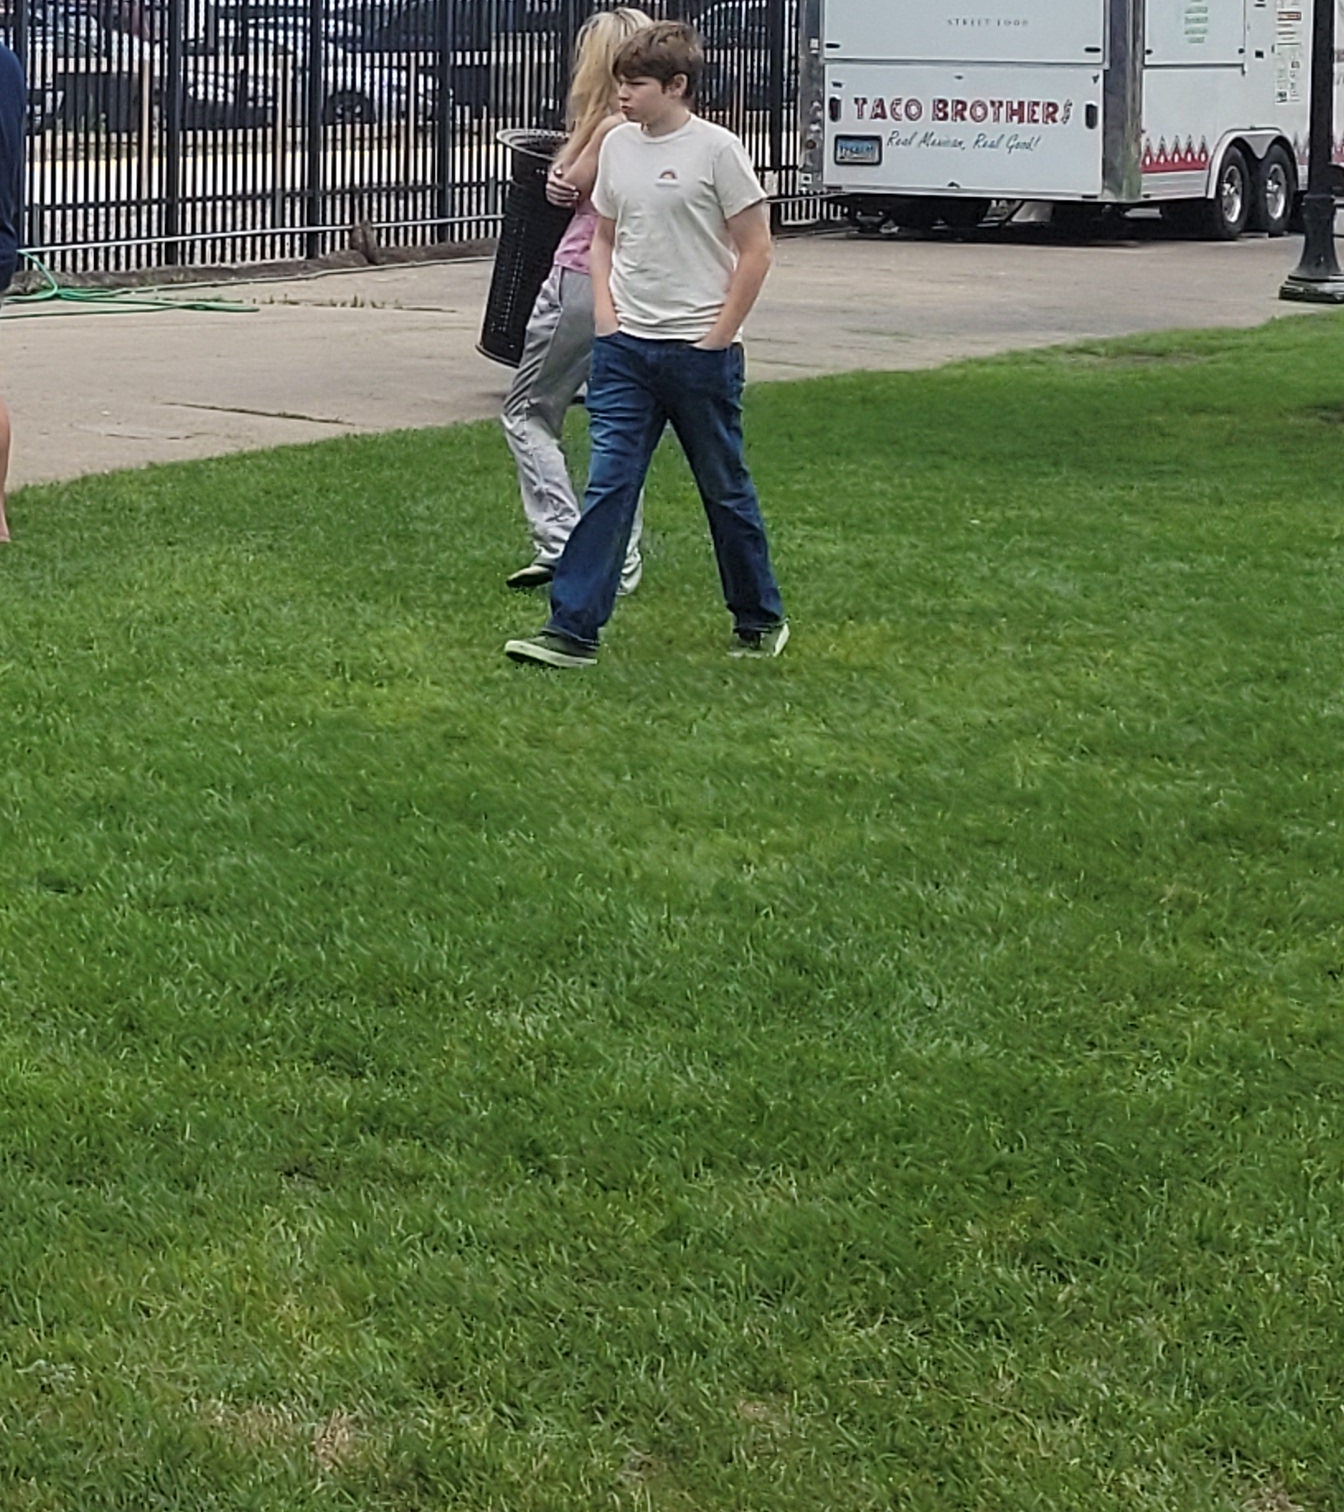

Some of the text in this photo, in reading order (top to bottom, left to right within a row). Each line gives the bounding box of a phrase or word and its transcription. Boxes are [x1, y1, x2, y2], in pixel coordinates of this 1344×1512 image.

[854, 97, 1072, 125] TACO BROTHERS
[887, 130, 916, 147] Real
[973, 133, 1005, 149] Real
